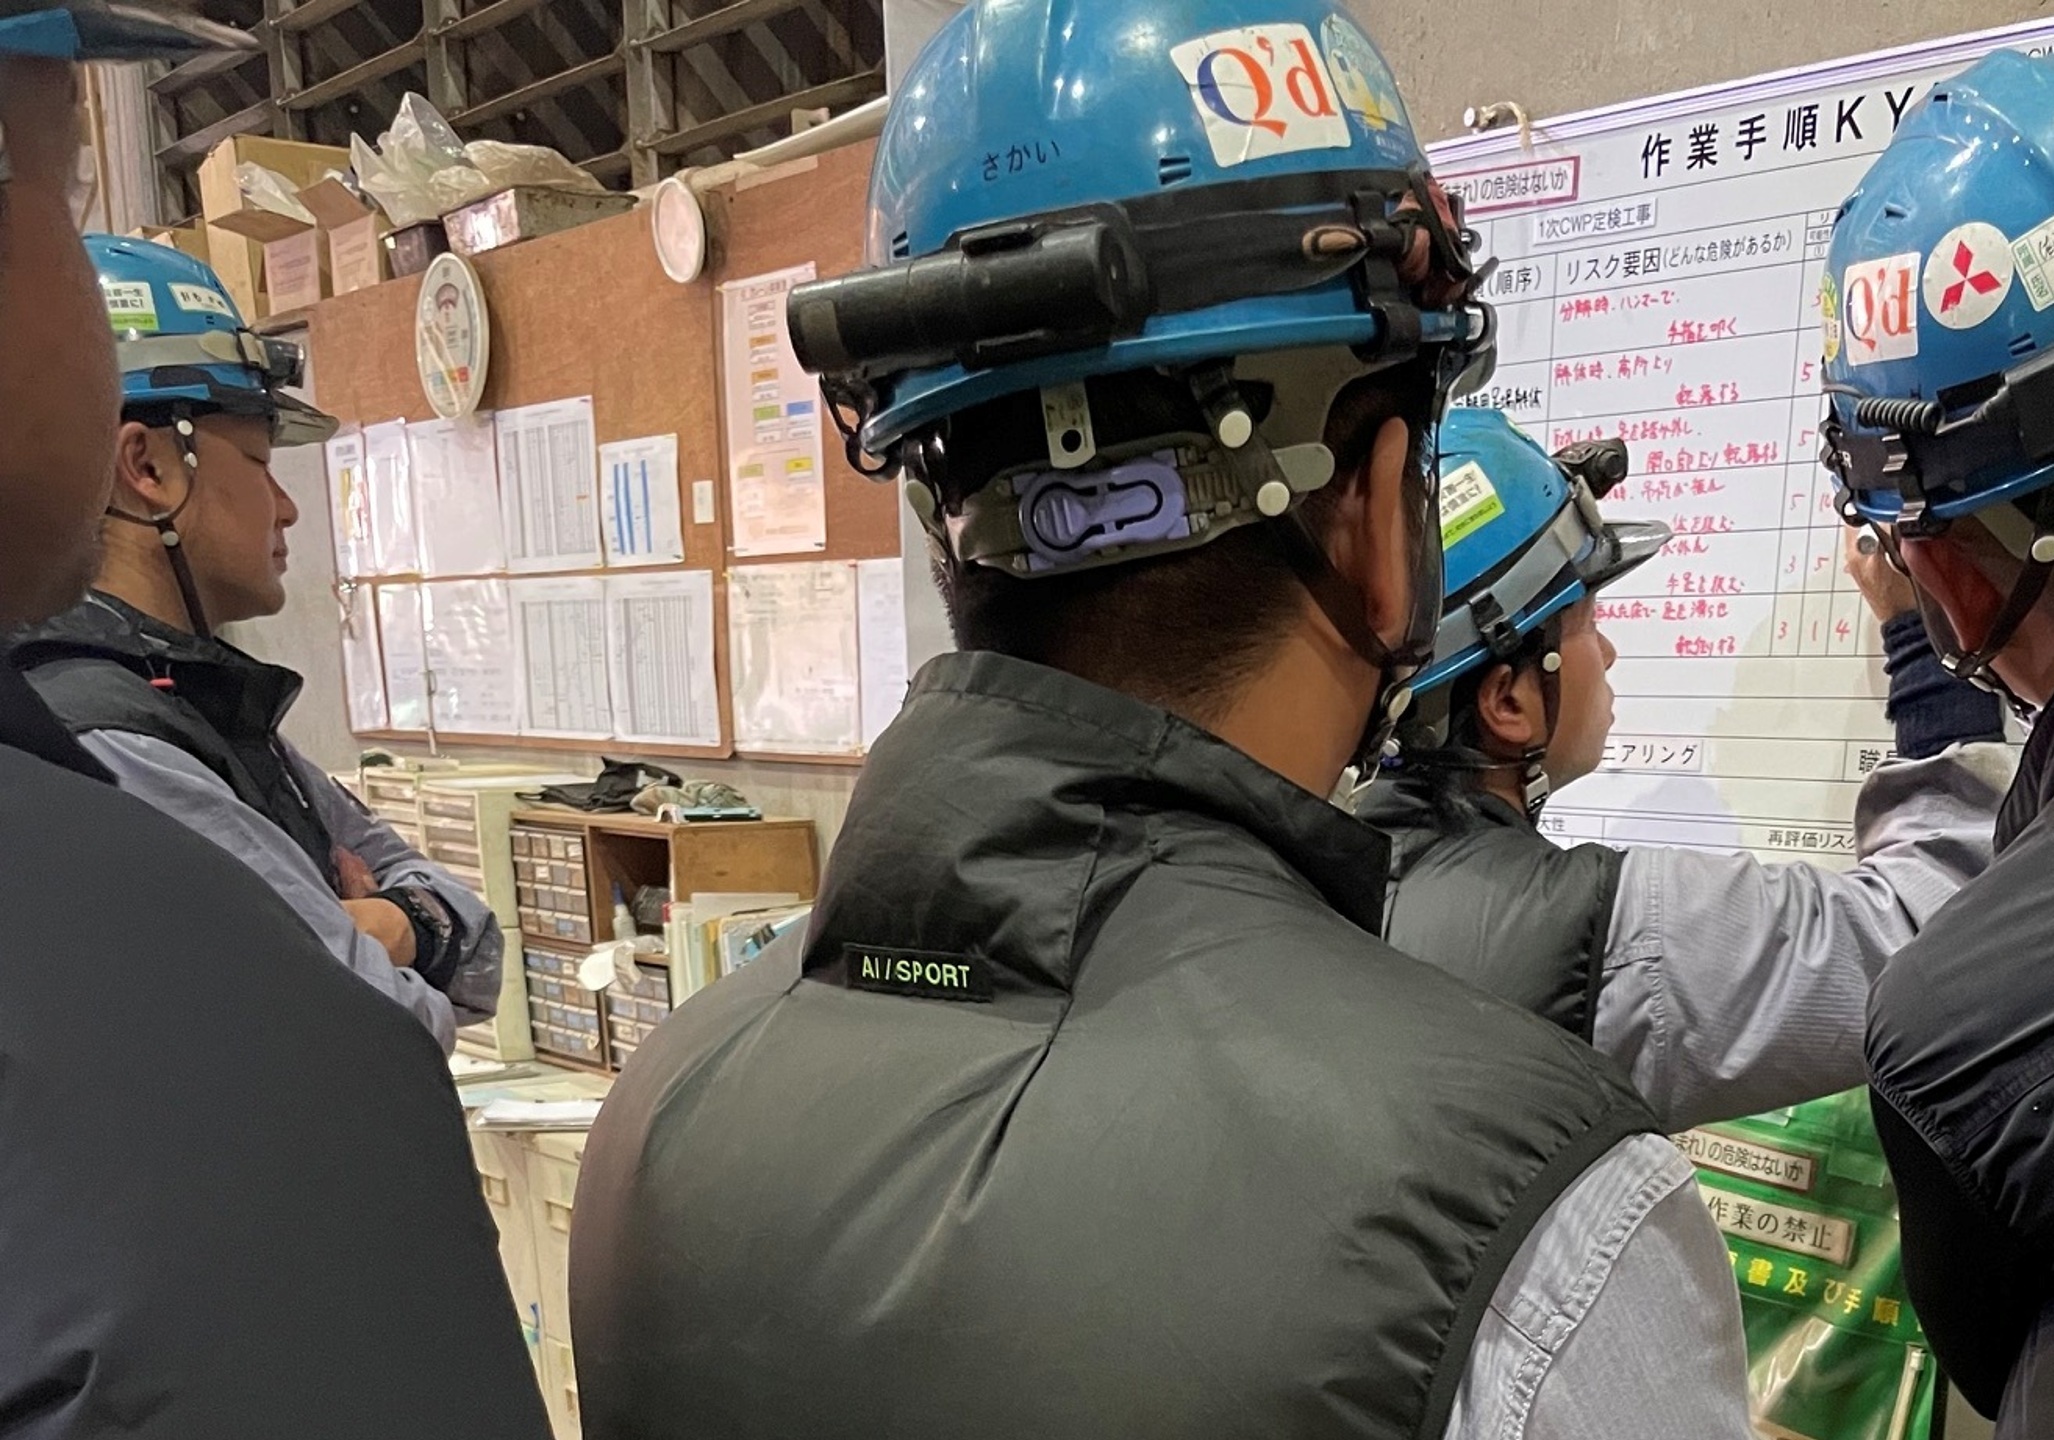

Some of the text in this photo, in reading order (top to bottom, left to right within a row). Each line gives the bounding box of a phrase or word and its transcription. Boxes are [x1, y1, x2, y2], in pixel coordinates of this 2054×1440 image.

[982, 140, 1061, 182] さかい
[1800, 362, 1815, 382] 5
[1797, 430, 1815, 447] 5
[1777, 621, 1789, 640] 3
[1835, 620, 1850, 643] 4
